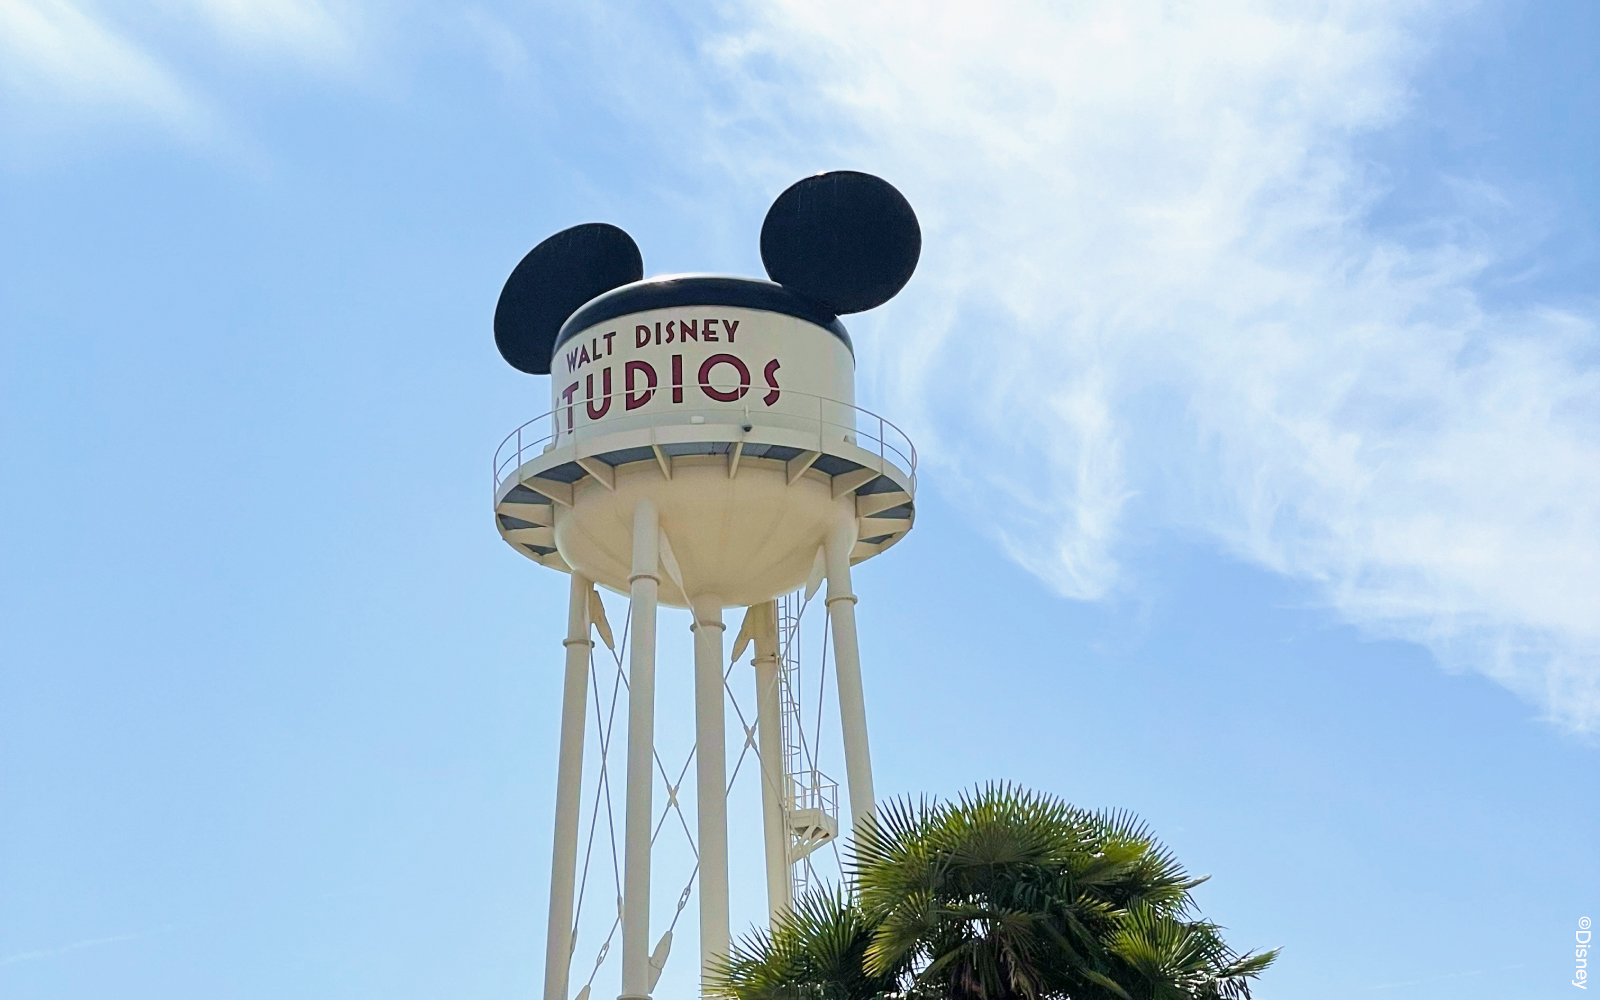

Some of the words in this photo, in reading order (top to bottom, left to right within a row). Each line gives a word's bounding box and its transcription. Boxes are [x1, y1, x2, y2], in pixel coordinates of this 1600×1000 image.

[566, 331, 617, 374] WALT
[636, 319, 740, 349] DISNEY
[551, 353, 781, 449] STUDIOS
